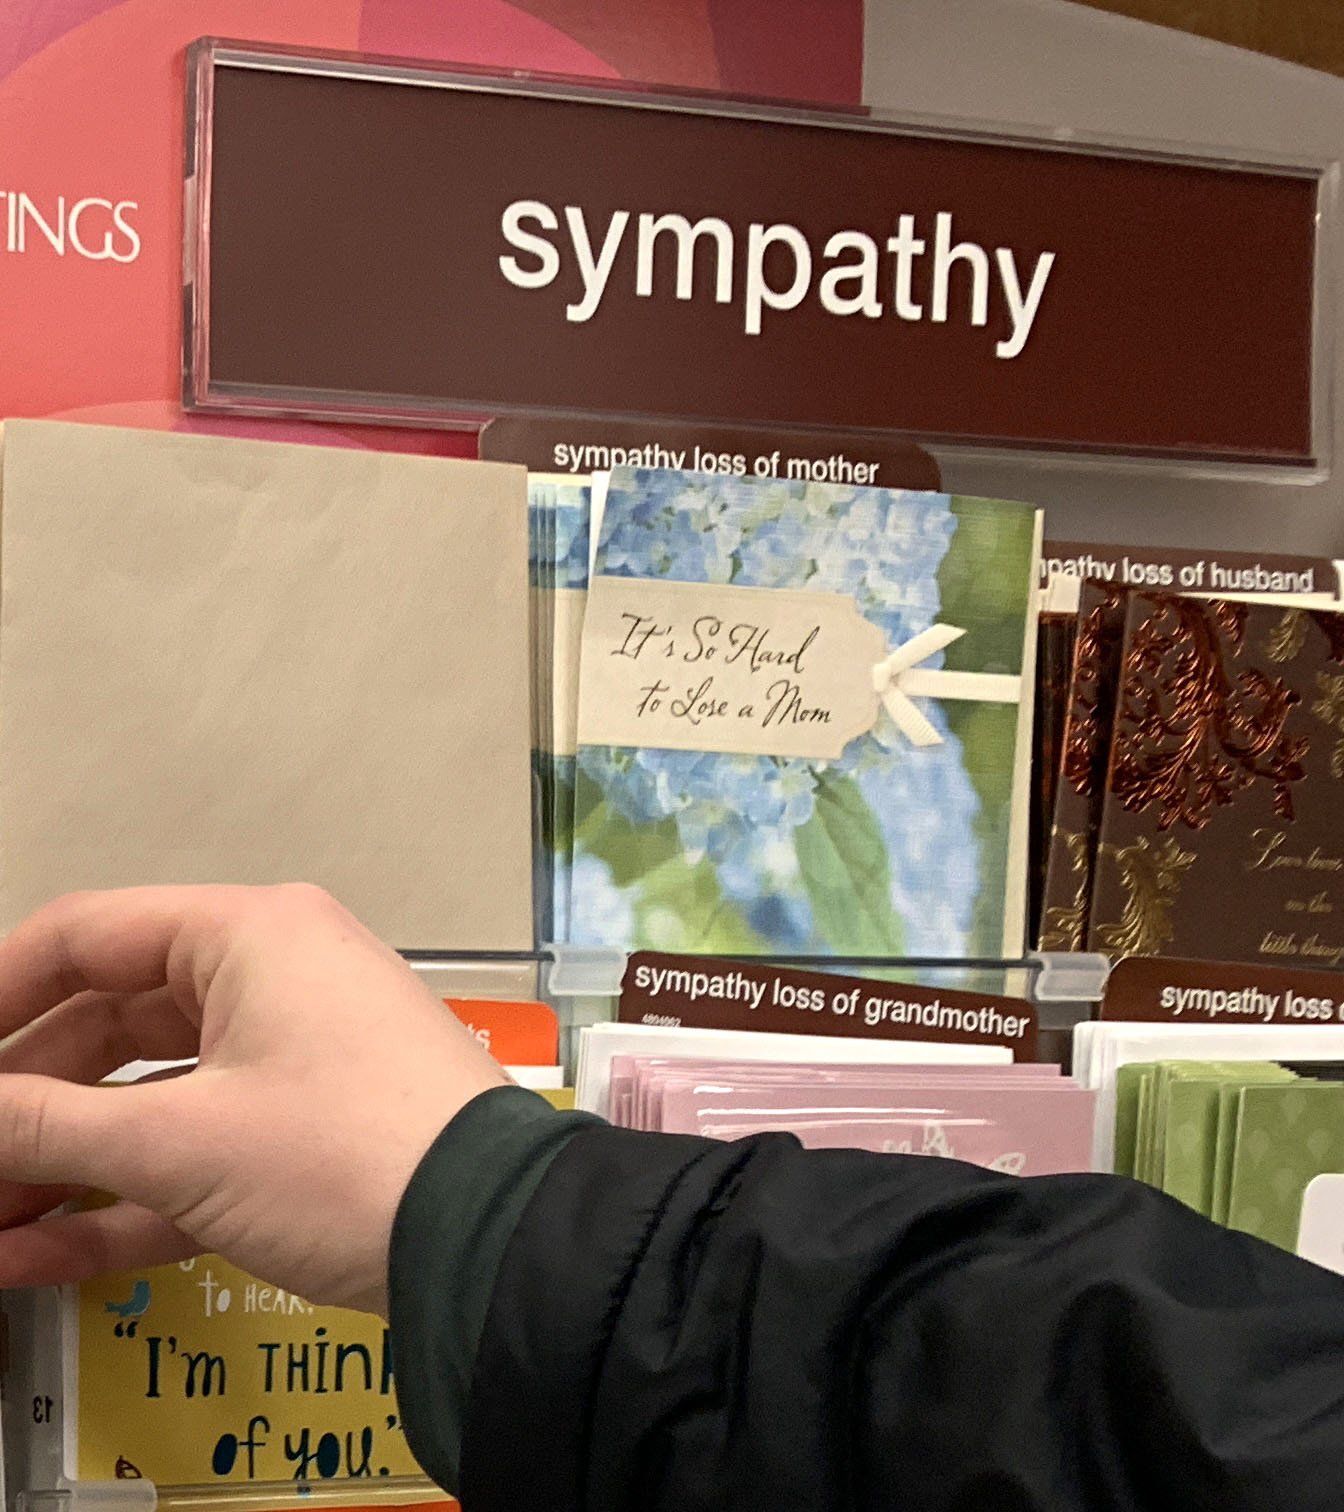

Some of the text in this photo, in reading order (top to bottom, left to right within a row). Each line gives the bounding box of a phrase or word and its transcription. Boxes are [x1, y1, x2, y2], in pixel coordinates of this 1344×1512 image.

[499, 200, 1055, 358] sympathy
[554, 441, 879, 485] sympathy loss of mother
[612, 613, 820, 673] It's So Hard
[637, 676, 830, 728] to Lose a Mom
[635, 966, 1030, 1037] sympathy loss of grandmother
